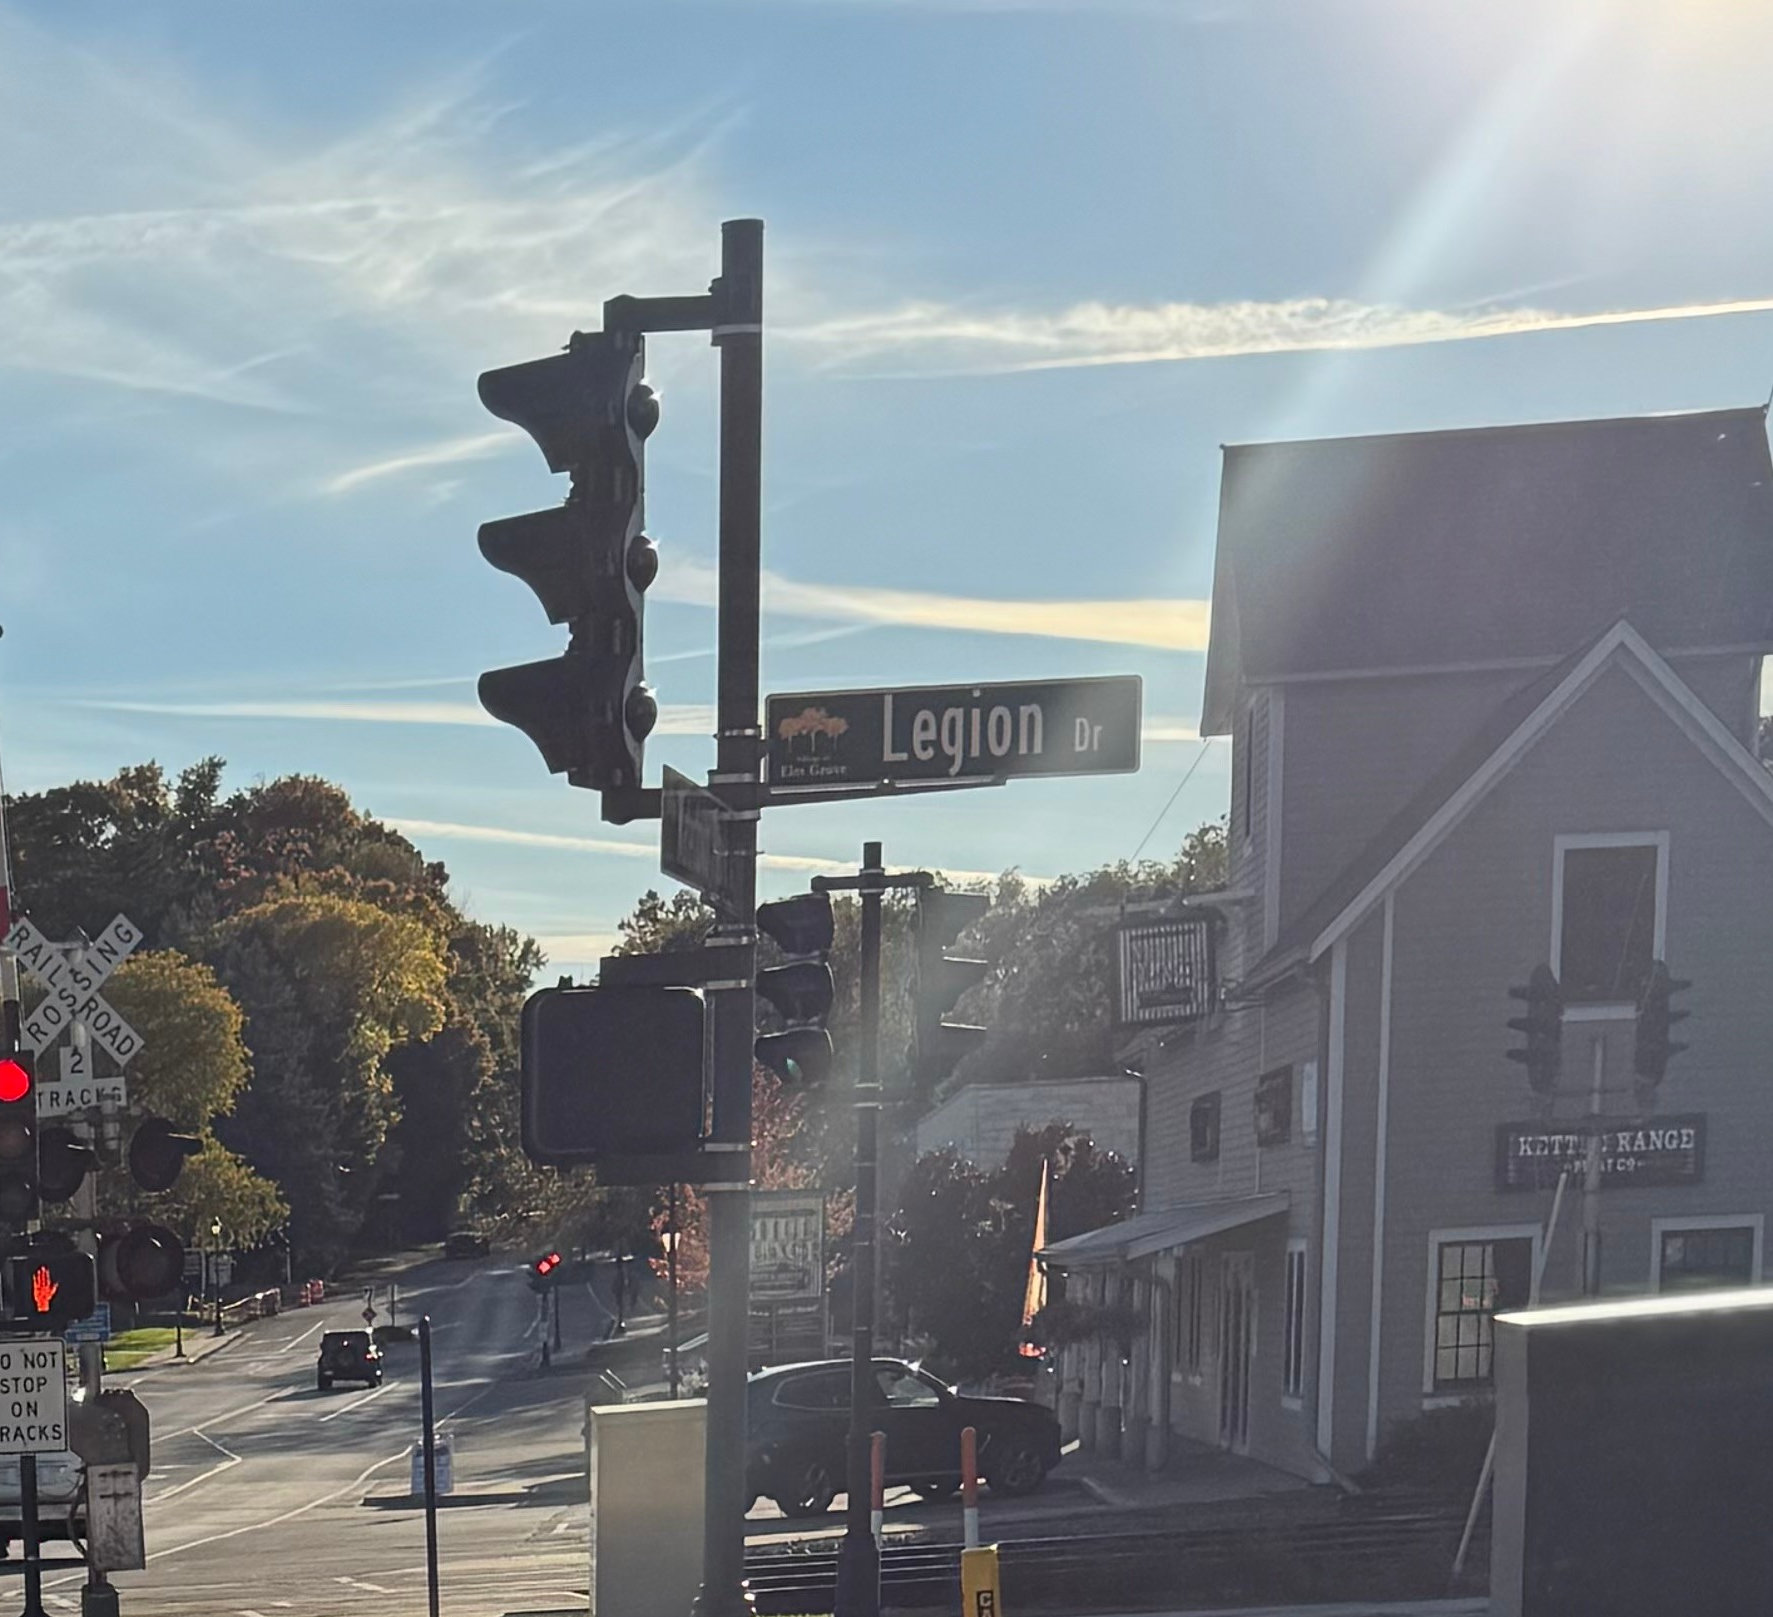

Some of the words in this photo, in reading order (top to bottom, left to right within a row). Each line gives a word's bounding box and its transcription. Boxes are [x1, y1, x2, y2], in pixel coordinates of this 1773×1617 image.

[883, 689, 1044, 776] Legion
[1074, 717, 1103, 752] Dr
[9, 925, 63, 988] RAIL
[78, 996, 135, 1057] ROAD
[27, 923, 134, 1044] ROSSING
[70, 1052, 84, 1074] 2
[1518, 1134, 1613, 1157] KETT
[1616, 1128, 1695, 1153] RANGE
[23, 1351, 58, 1369] NOT
[0, 1377, 47, 1394] STOP
[11, 1401, 38, 1418] ON
